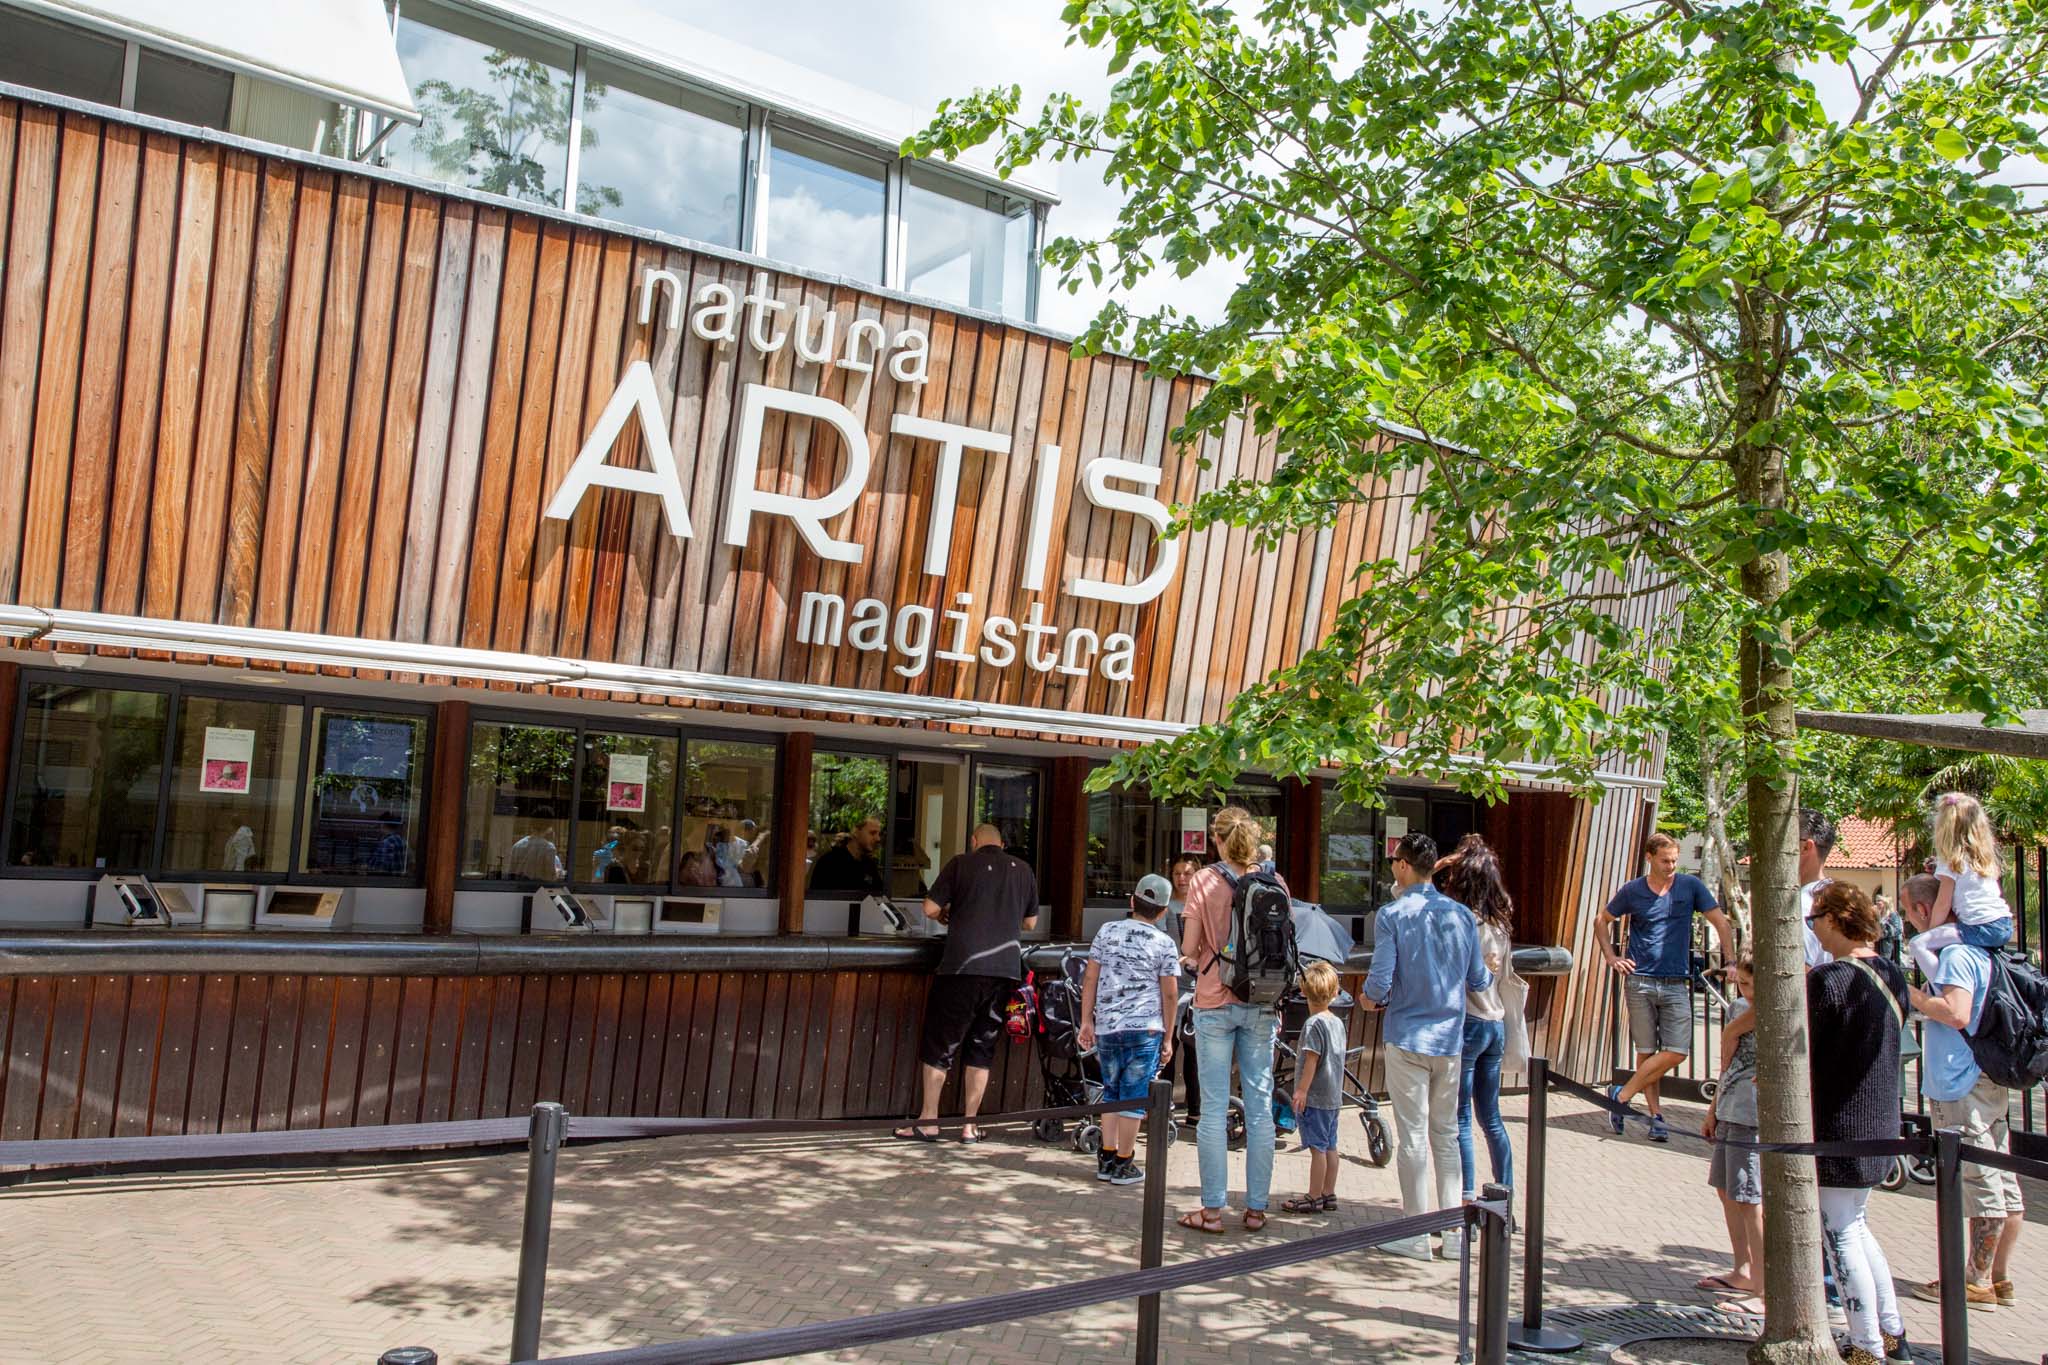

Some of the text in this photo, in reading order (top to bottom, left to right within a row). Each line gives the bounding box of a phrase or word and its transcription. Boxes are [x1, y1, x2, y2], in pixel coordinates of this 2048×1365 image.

[638, 268, 929, 384] natura
[544, 361, 1177, 605] ARTIS
[796, 591, 1135, 682] magistra
